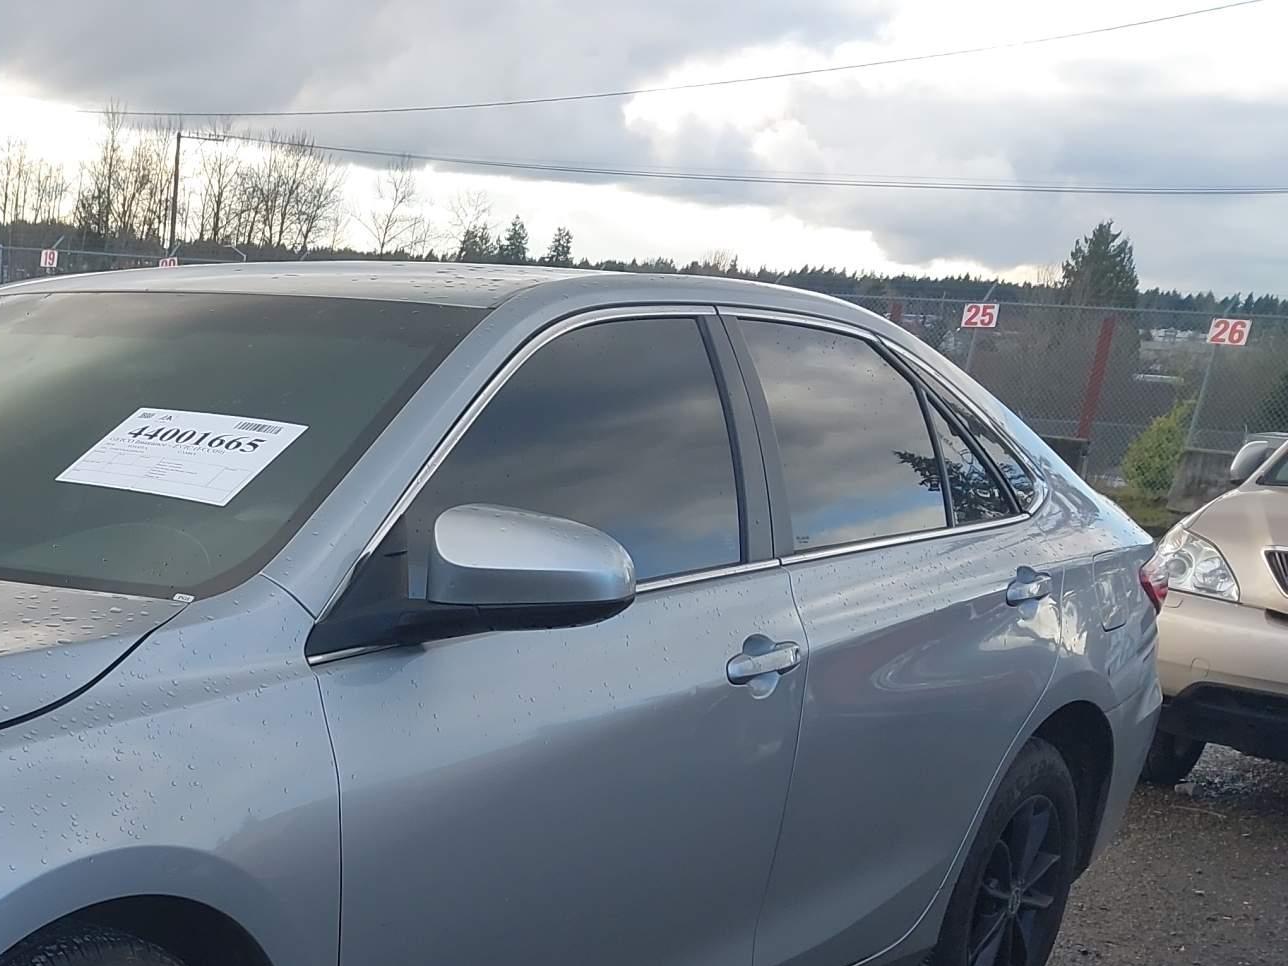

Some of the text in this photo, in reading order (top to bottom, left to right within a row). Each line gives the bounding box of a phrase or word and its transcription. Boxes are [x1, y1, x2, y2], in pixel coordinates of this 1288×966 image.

[44, 251, 56, 266] 19
[964, 304, 995, 327] 25
[1211, 320, 1247, 345] 26
[128, 425, 268, 453] 44001665
